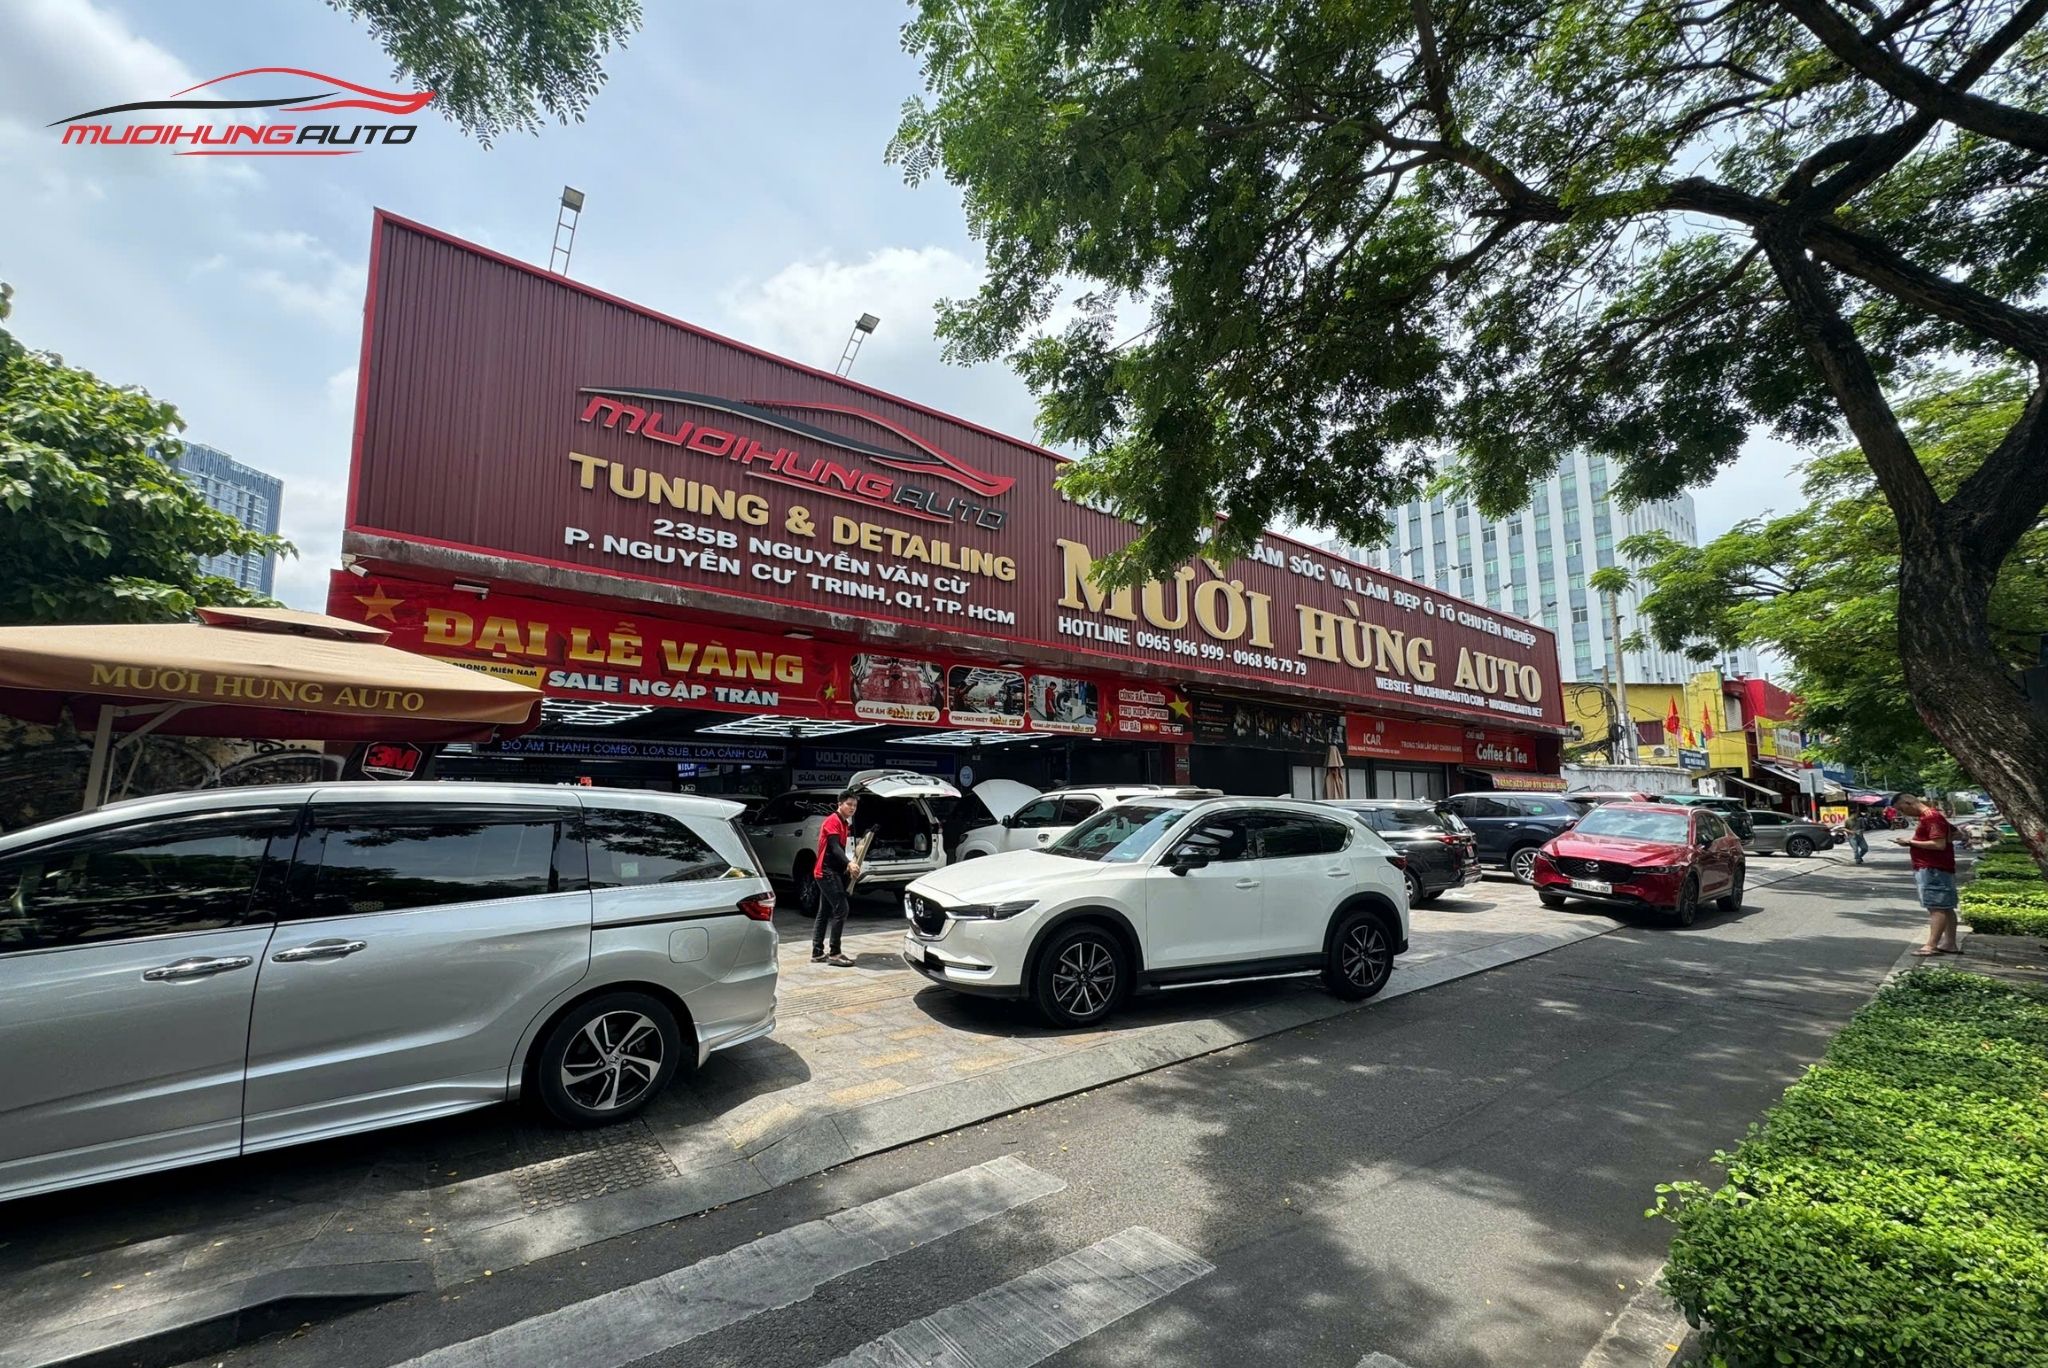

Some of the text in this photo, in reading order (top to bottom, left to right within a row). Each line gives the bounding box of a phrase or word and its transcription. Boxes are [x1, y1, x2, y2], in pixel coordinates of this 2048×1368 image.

[568, 451, 1016, 582] TUNING & DETAILING
[564, 526, 594, 550] P.
[603, 536, 740, 575] NGUYỄN
[751, 563, 798, 584] CƯ
[653, 517, 970, 595] 235B NGUYỄN VĂN CỪ
[1289, 554, 1325, 582] SÓC
[1330, 567, 1352, 591] VÀ
[1355, 575, 1389, 602] LÀM
[1393, 590, 1420, 613] ĐẸP
[1423, 597, 1435, 616] Ô
[1437, 602, 1456, 622] TÔ
[1457, 611, 1501, 637] CHUYÊN
[1502, 627, 1537, 649] NGHIỆP
[1056, 538, 1543, 703] MƯỜI HÙNG AUTO
[423, 607, 804, 684] ĐẠI LỄ VÀNG
[1137, 631, 1171, 652] 0965
[1174, 638, 1198, 657] 966
[1201, 643, 1224, 661] 999
[1233, 649, 1262, 668] 0968
[517, 669, 537, 677] NAM
[548, 671, 779, 706] SALE NGẬP TRÀN
[333, 686, 424, 712] AUTO
[548, 741, 590, 753] THANH
[643, 745, 666, 755] LOA
[695, 747, 716, 757] LOA
[1363, 733, 1381, 746] ICAR
[1476, 743, 1503, 761] Coffee
[1513, 747, 1528, 764] Tea
[368, 745, 418, 771] 3M
[815, 751, 875, 765] VOLTRONIC
